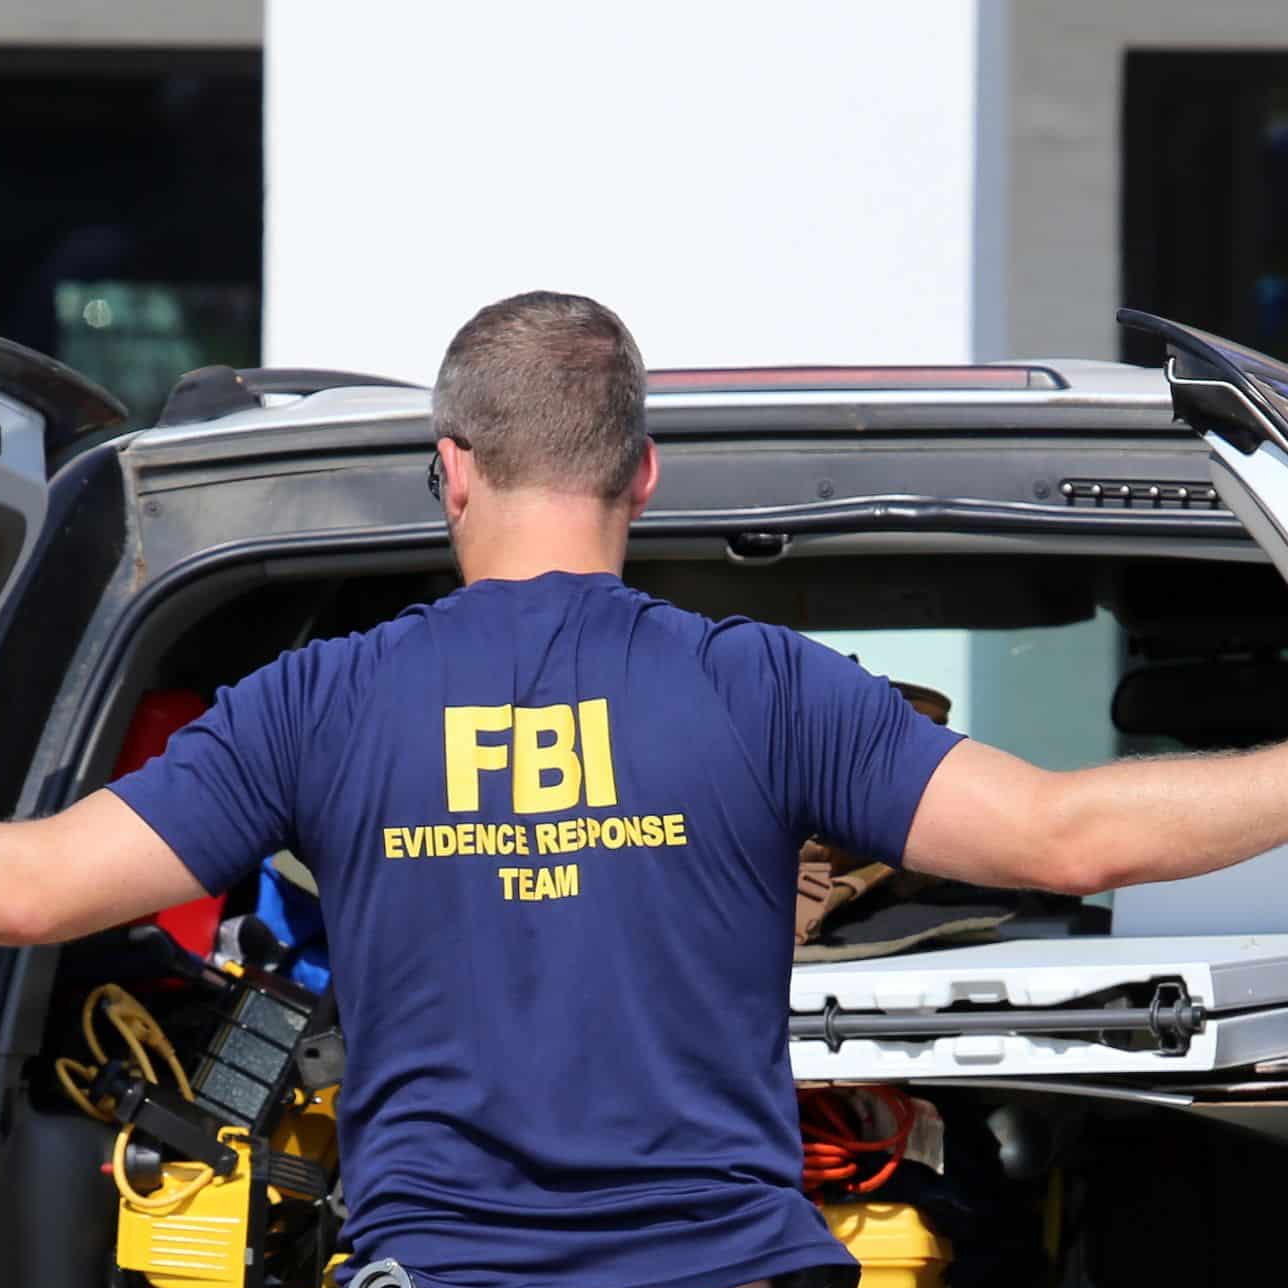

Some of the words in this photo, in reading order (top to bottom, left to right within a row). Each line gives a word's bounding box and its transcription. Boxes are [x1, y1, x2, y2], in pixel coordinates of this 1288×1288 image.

[444, 698, 617, 814] FBI
[383, 823, 529, 858] EVIDENCE
[499, 864, 578, 900] TEAM
